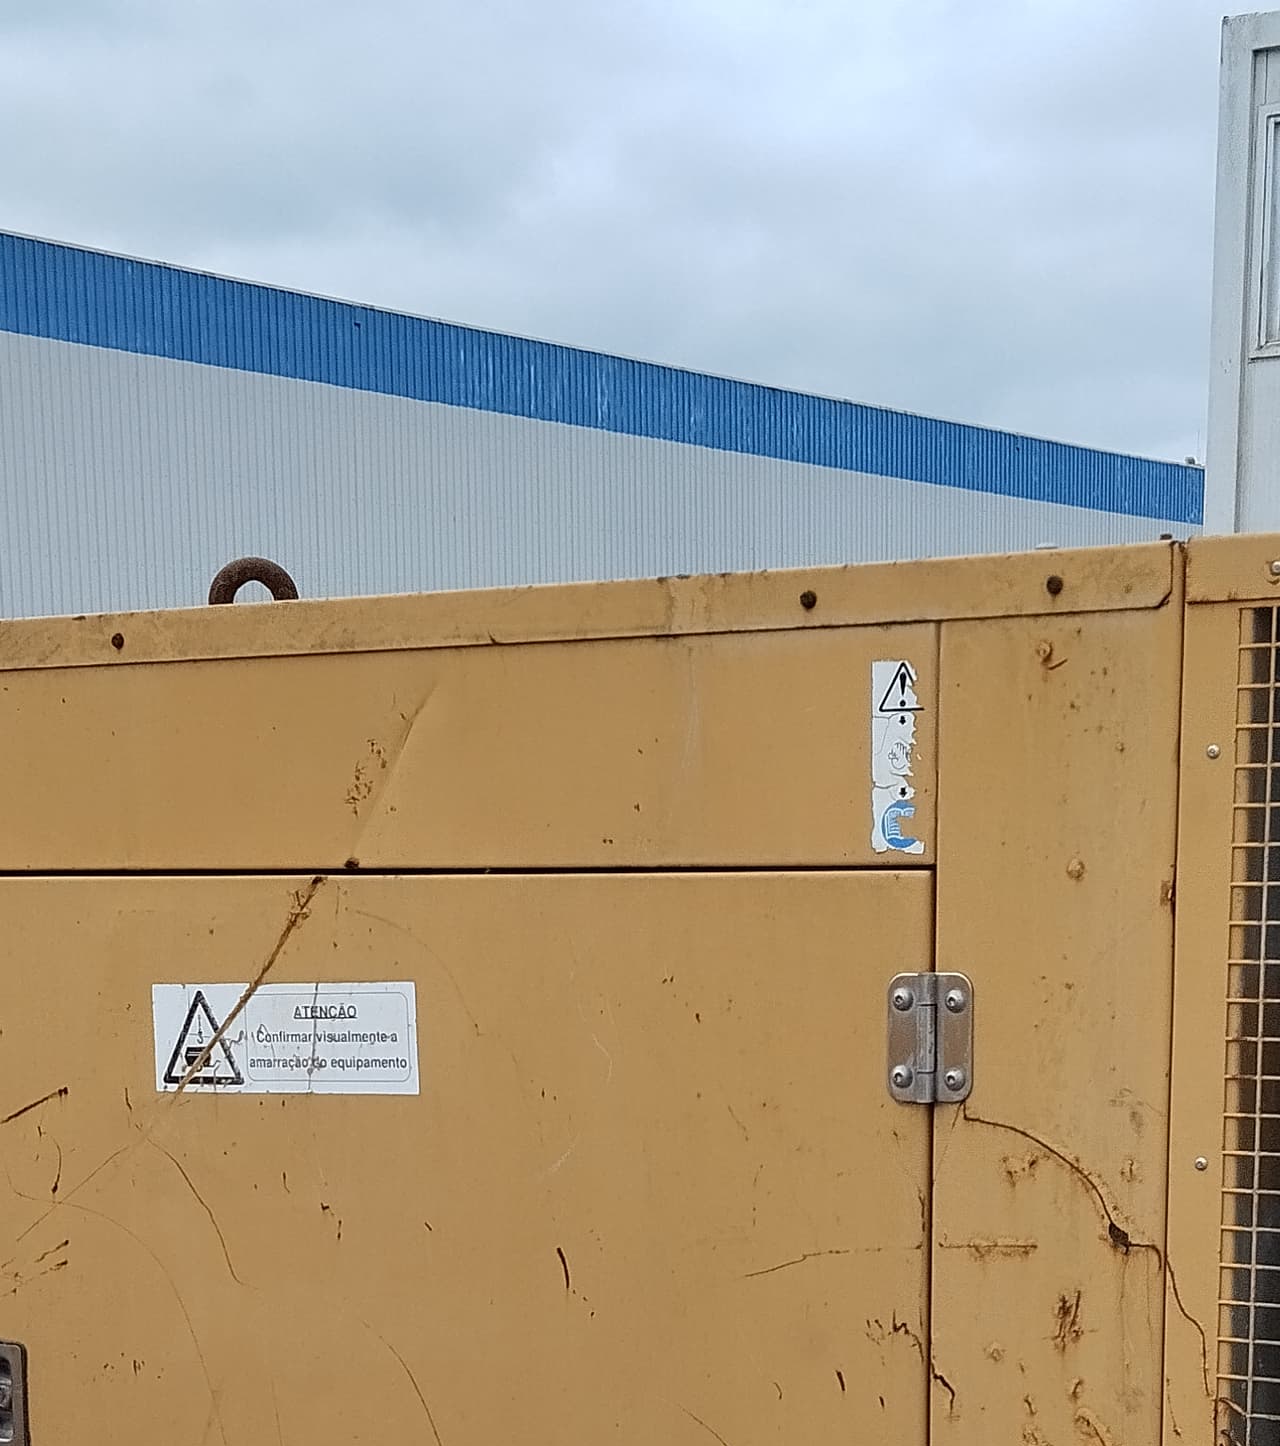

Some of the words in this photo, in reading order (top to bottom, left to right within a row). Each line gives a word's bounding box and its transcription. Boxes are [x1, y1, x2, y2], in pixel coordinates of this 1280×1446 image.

[293, 1003, 358, 1021] ATENÇÃO
[256, 1028, 314, 1044] Confirmar
[316, 1029, 387, 1044] visualmente
[249, 1055, 311, 1071] amarração
[330, 1057, 408, 1071] equipamento
